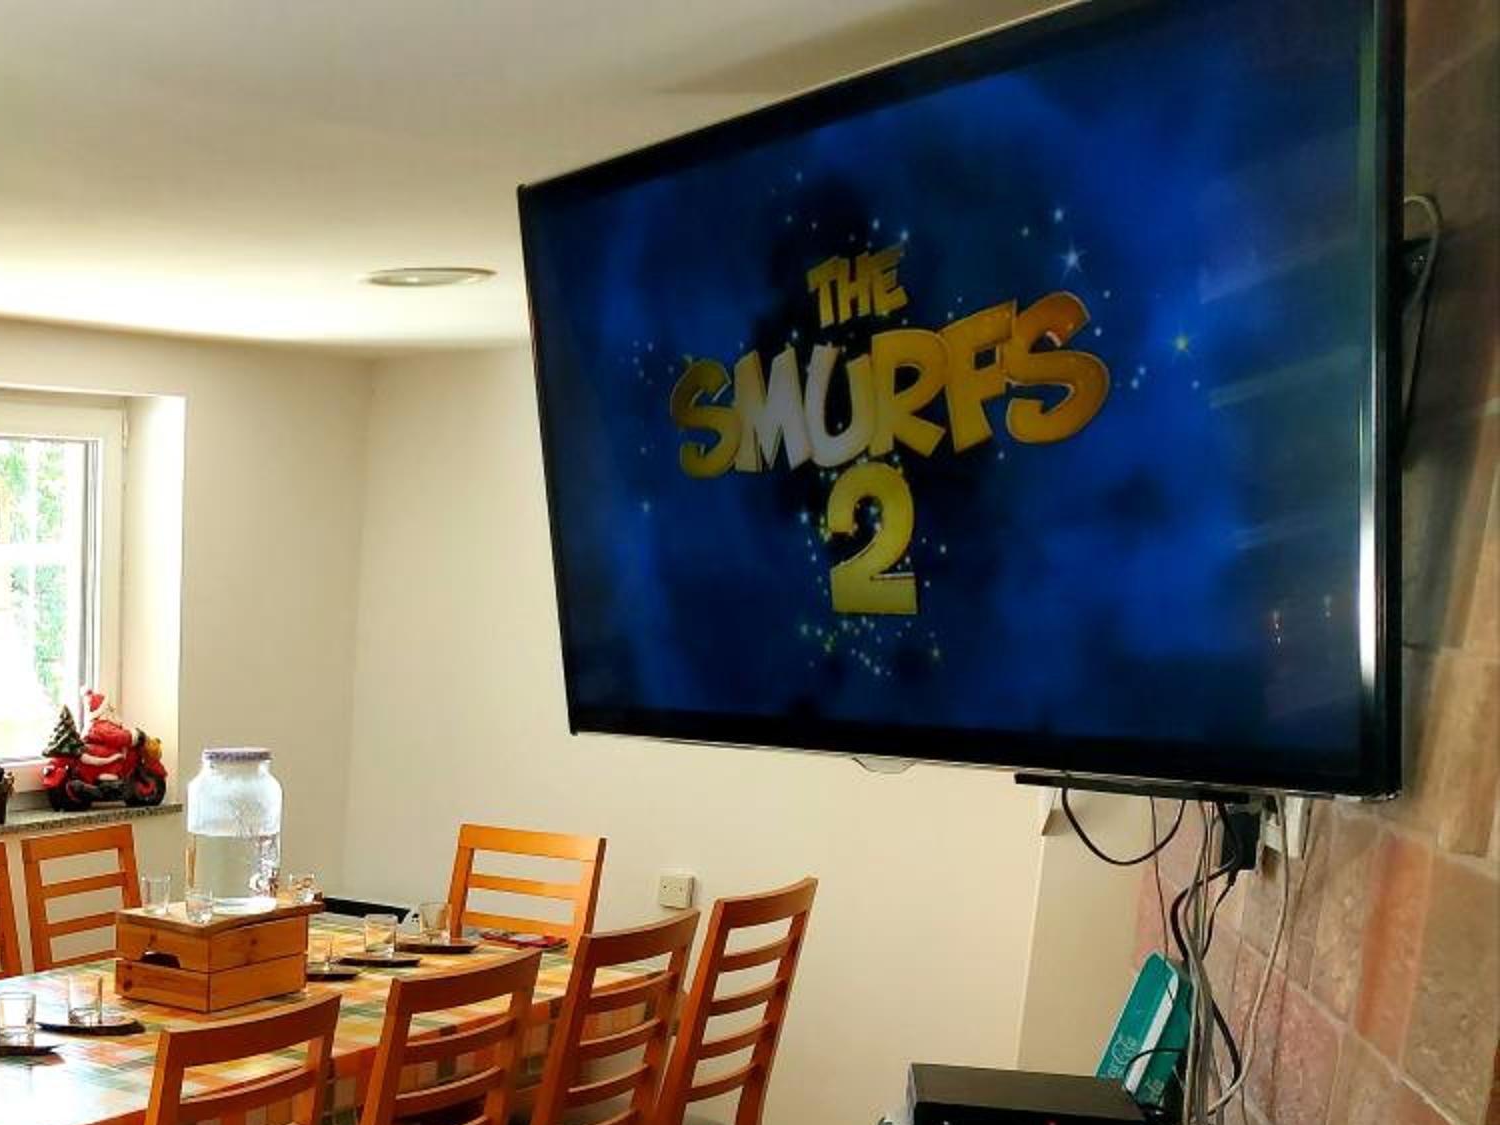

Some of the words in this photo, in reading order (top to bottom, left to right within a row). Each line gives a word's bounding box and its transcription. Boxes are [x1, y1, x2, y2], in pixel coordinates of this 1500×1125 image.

[807, 248, 908, 330] THE
[670, 292, 1110, 480] SMURFS
[827, 462, 918, 615] 2
